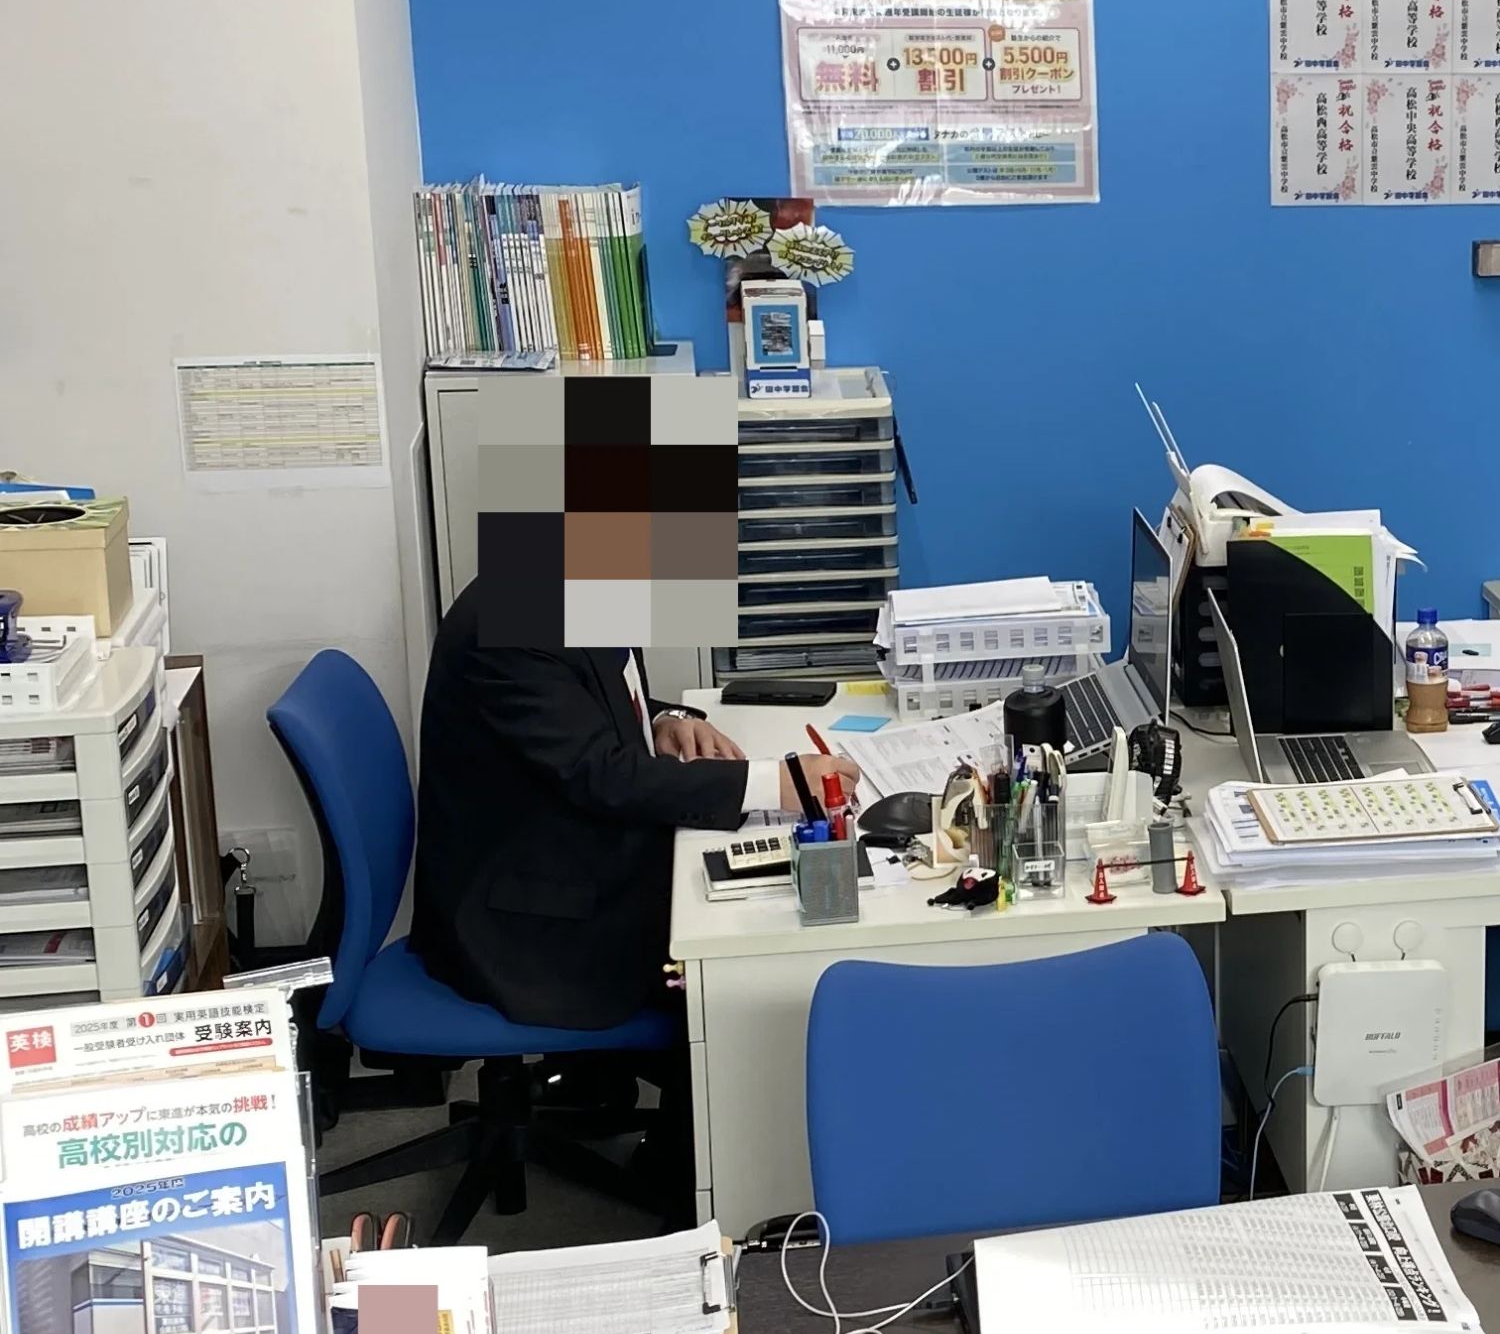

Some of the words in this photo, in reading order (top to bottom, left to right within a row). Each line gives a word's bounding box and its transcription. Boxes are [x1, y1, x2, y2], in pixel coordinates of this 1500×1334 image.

[816, 60, 879, 93] 無料
[918, 69, 965, 92] 割引
[1000, 68, 1074, 82] 割引クーポン
[1317, 93, 1327, 175] 高松西高等学校
[1339, 104, 1353, 151] 祝合格
[1406, 87, 1417, 180] 高松中央高等学校
[1428, 105, 1443, 151] 祝合格
[9, 1031, 53, 1052] 英検
[195, 1019, 272, 1042] 受験案内
[1365, 1032, 1401, 1041] BUFFALO
[23, 1094, 277, 1137] 高校の成績アップに東進が本気の挑戦!
[57, 1121, 248, 1168] 高校別対応の
